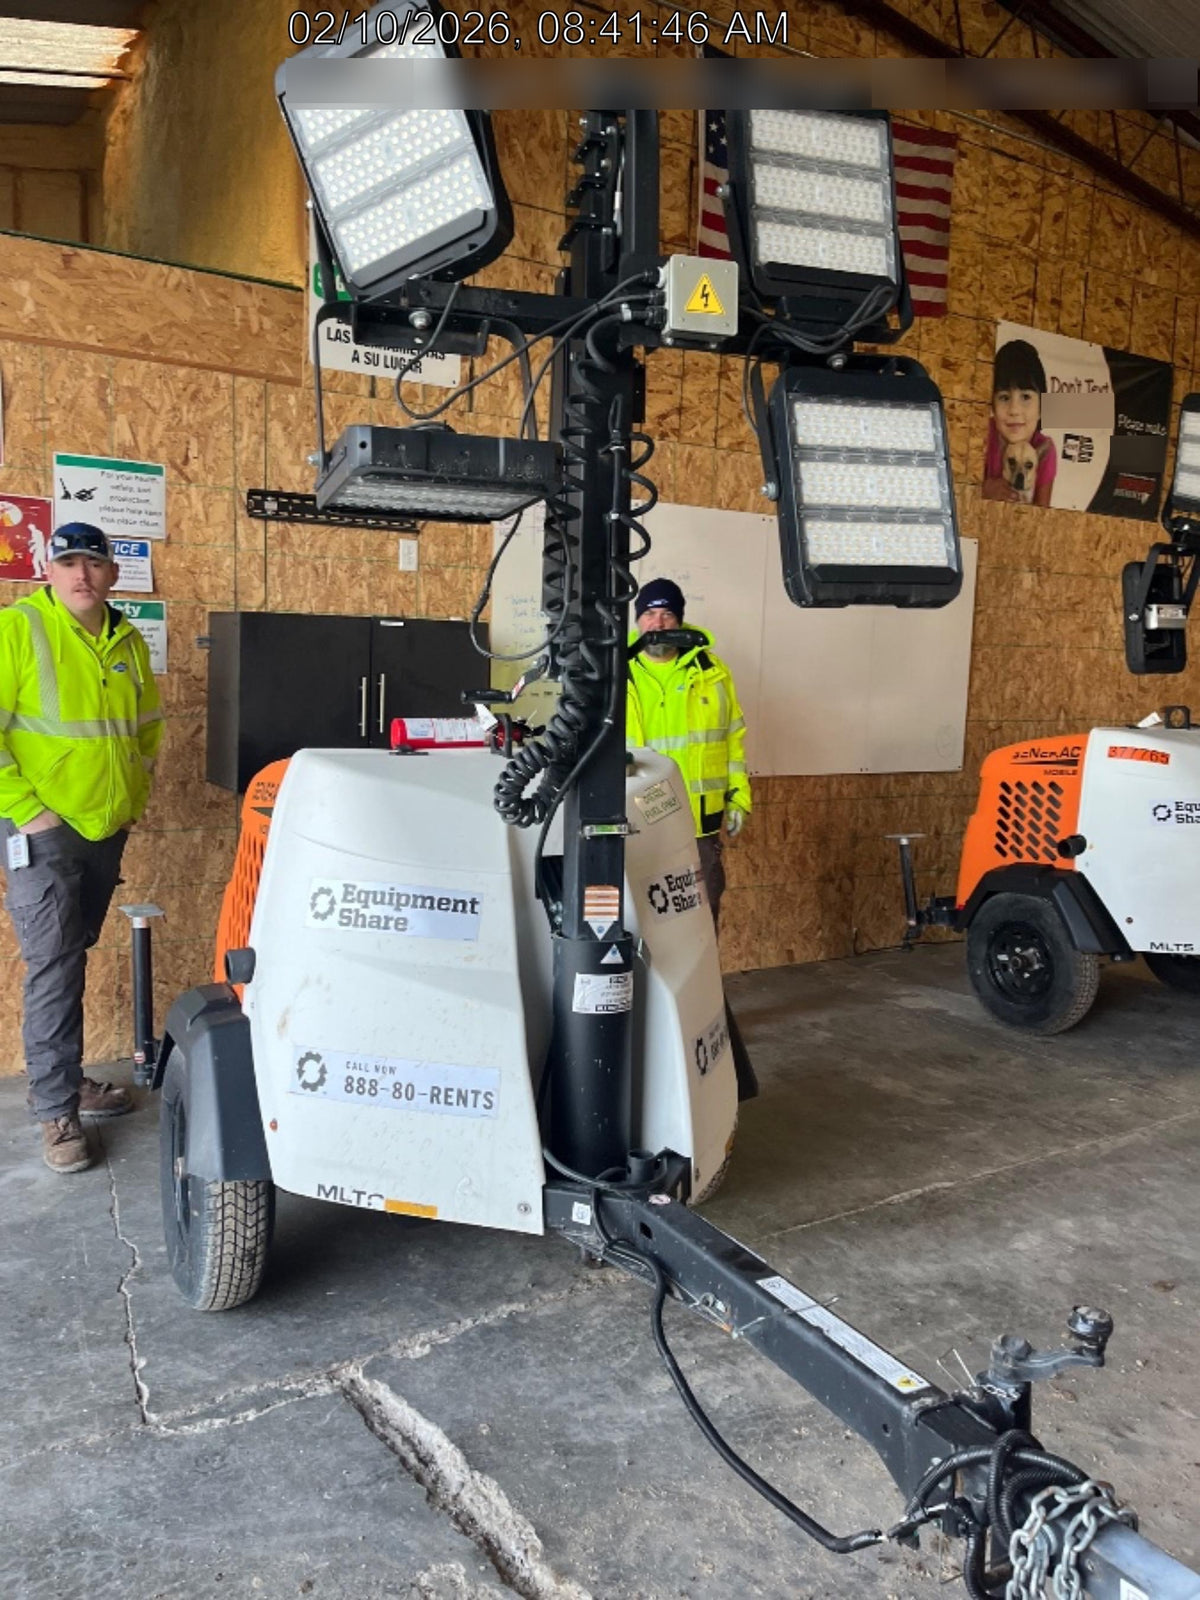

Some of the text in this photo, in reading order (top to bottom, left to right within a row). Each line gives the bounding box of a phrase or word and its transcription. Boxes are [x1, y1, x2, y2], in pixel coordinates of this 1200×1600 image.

[326, 326, 351, 344] LAS
[351, 350, 360, 363] A
[364, 352, 380, 367] SU
[1050, 376, 1109, 394] Don't Text
[115, 542, 140, 556] ICE
[341, 883, 479, 915] Equipment
[338, 907, 409, 932] Share
[1150, 942, 1194, 952] MLTS
[346, 1060, 398, 1075] CALL NOW
[344, 1075, 494, 1110] 888-80-RENTS
